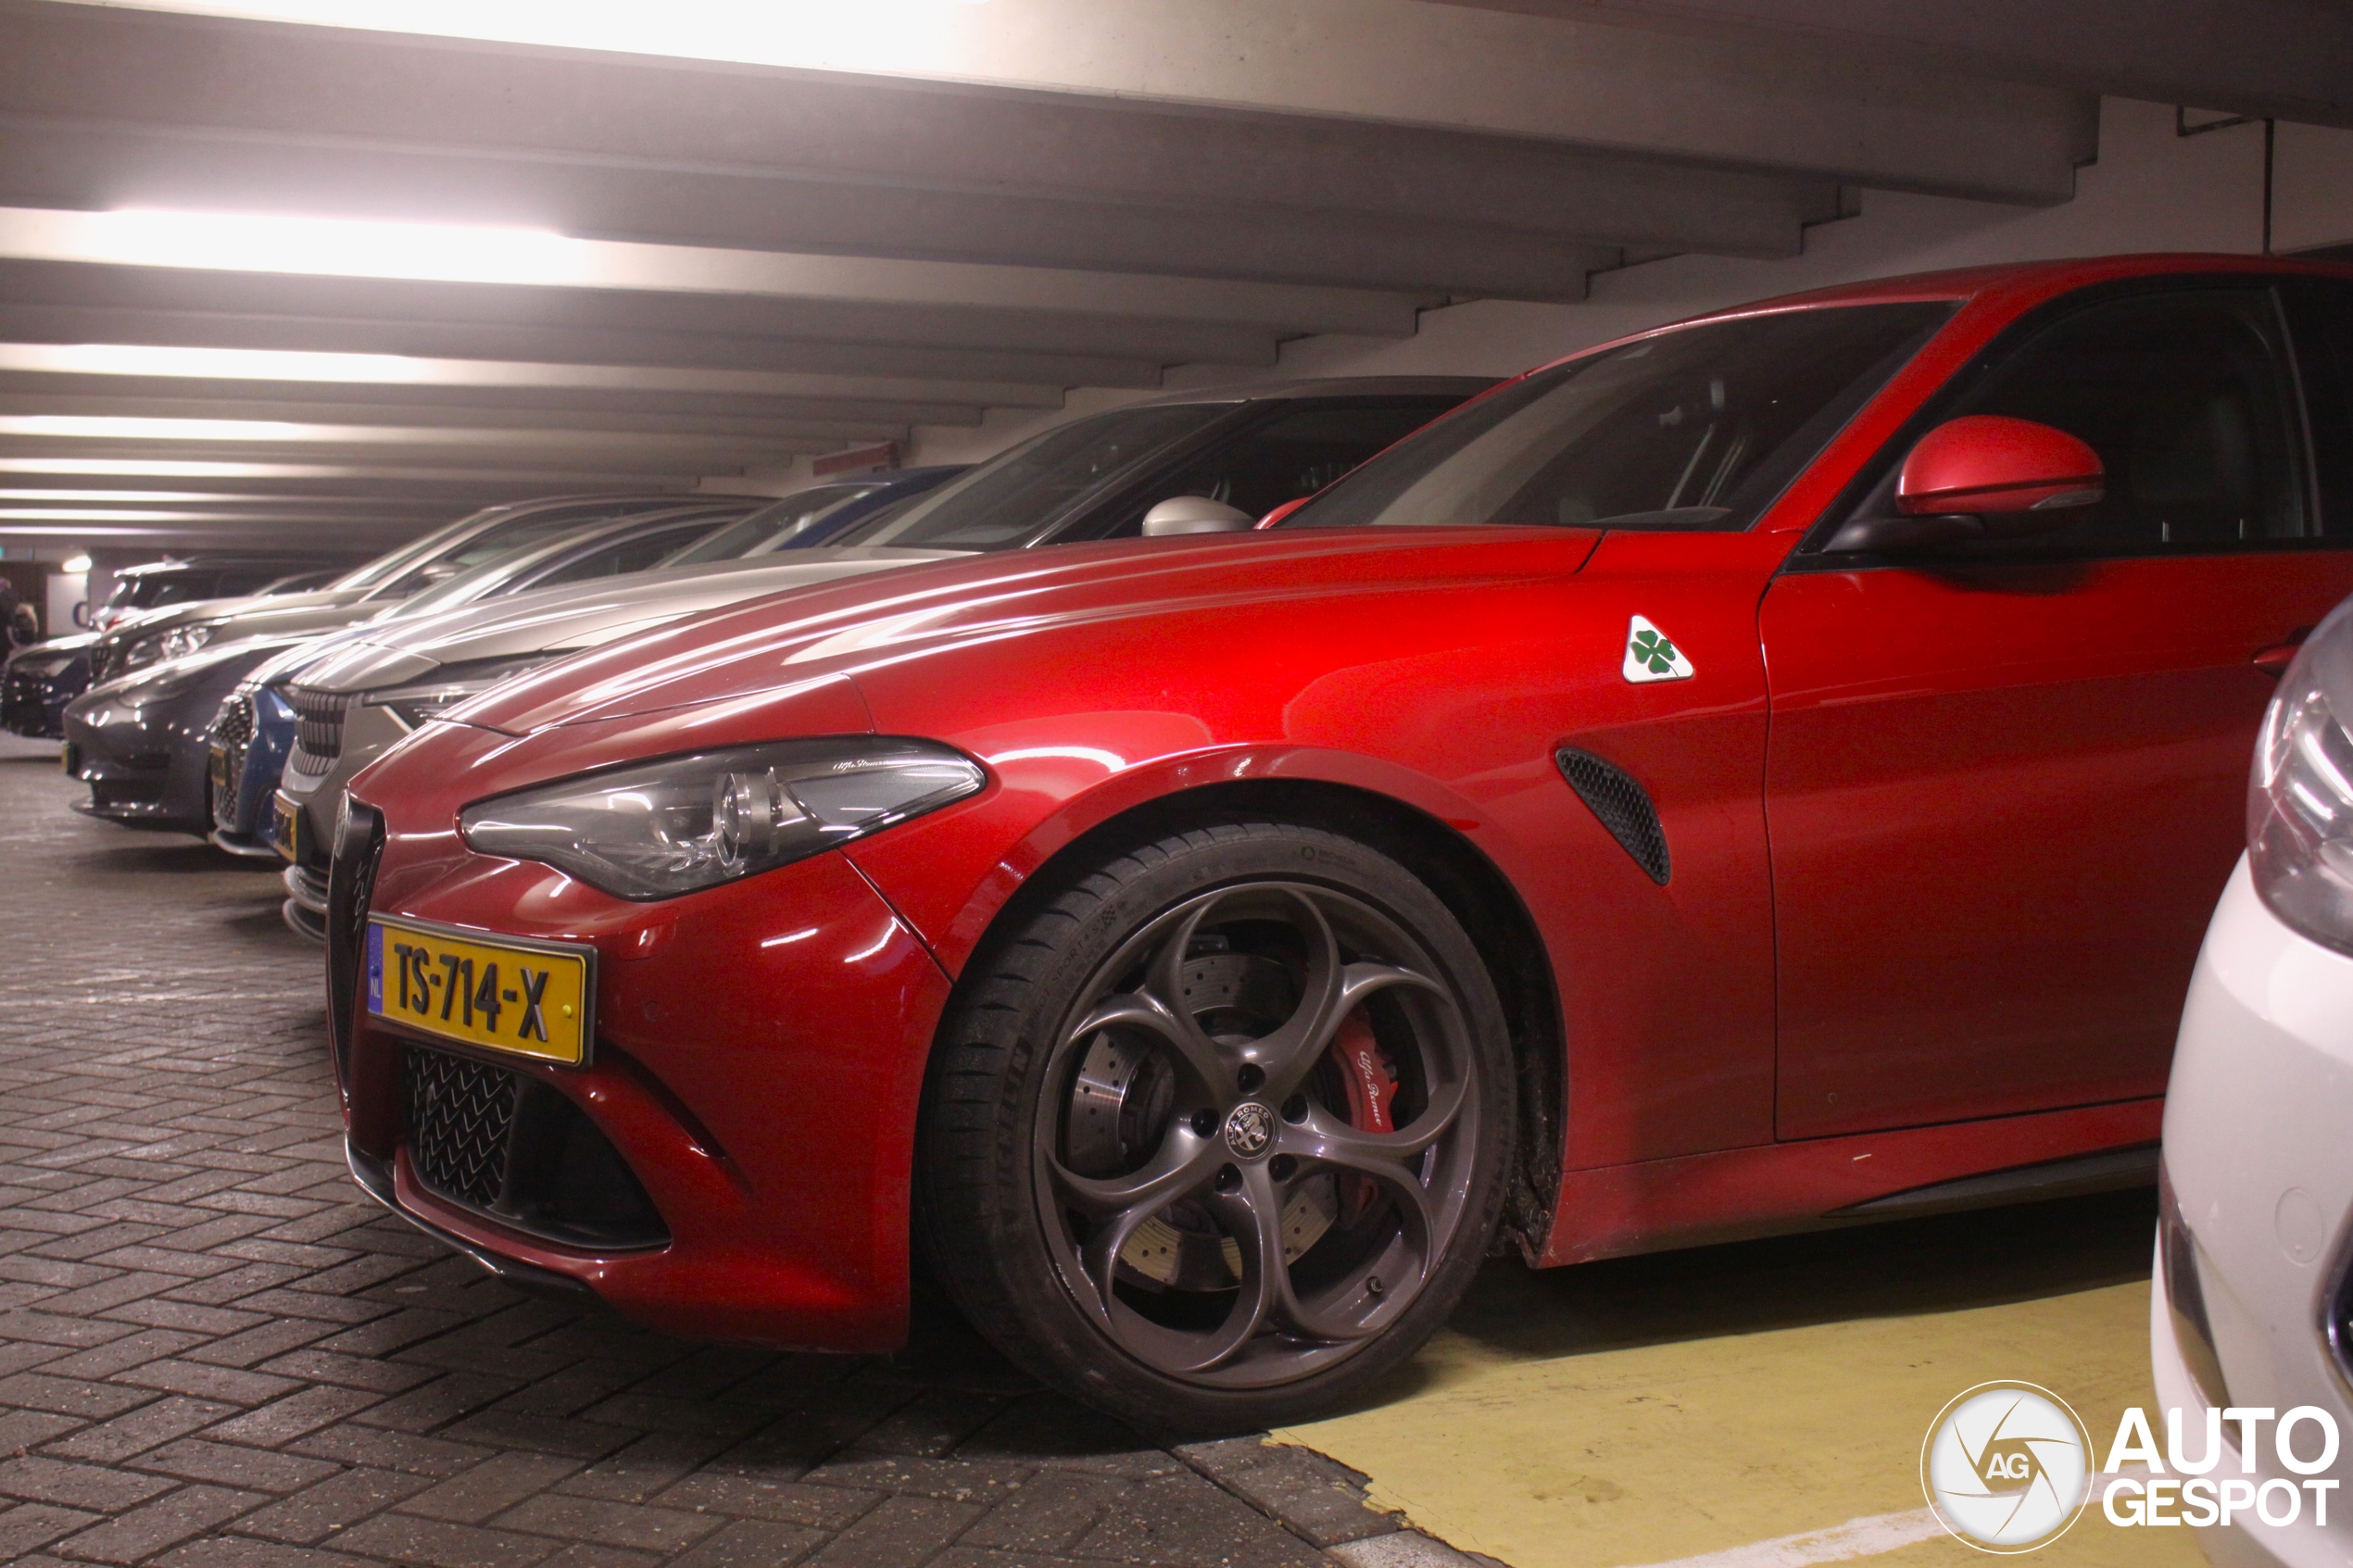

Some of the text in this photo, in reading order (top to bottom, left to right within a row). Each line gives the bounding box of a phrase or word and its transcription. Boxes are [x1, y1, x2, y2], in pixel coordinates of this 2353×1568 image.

[371, 977, 382, 998] NL
[394, 943, 548, 1043] TS-714-X
[1357, 1050, 1374, 1082] Alfa
[1228, 1106, 1269, 1146] ALFA ROMEO
